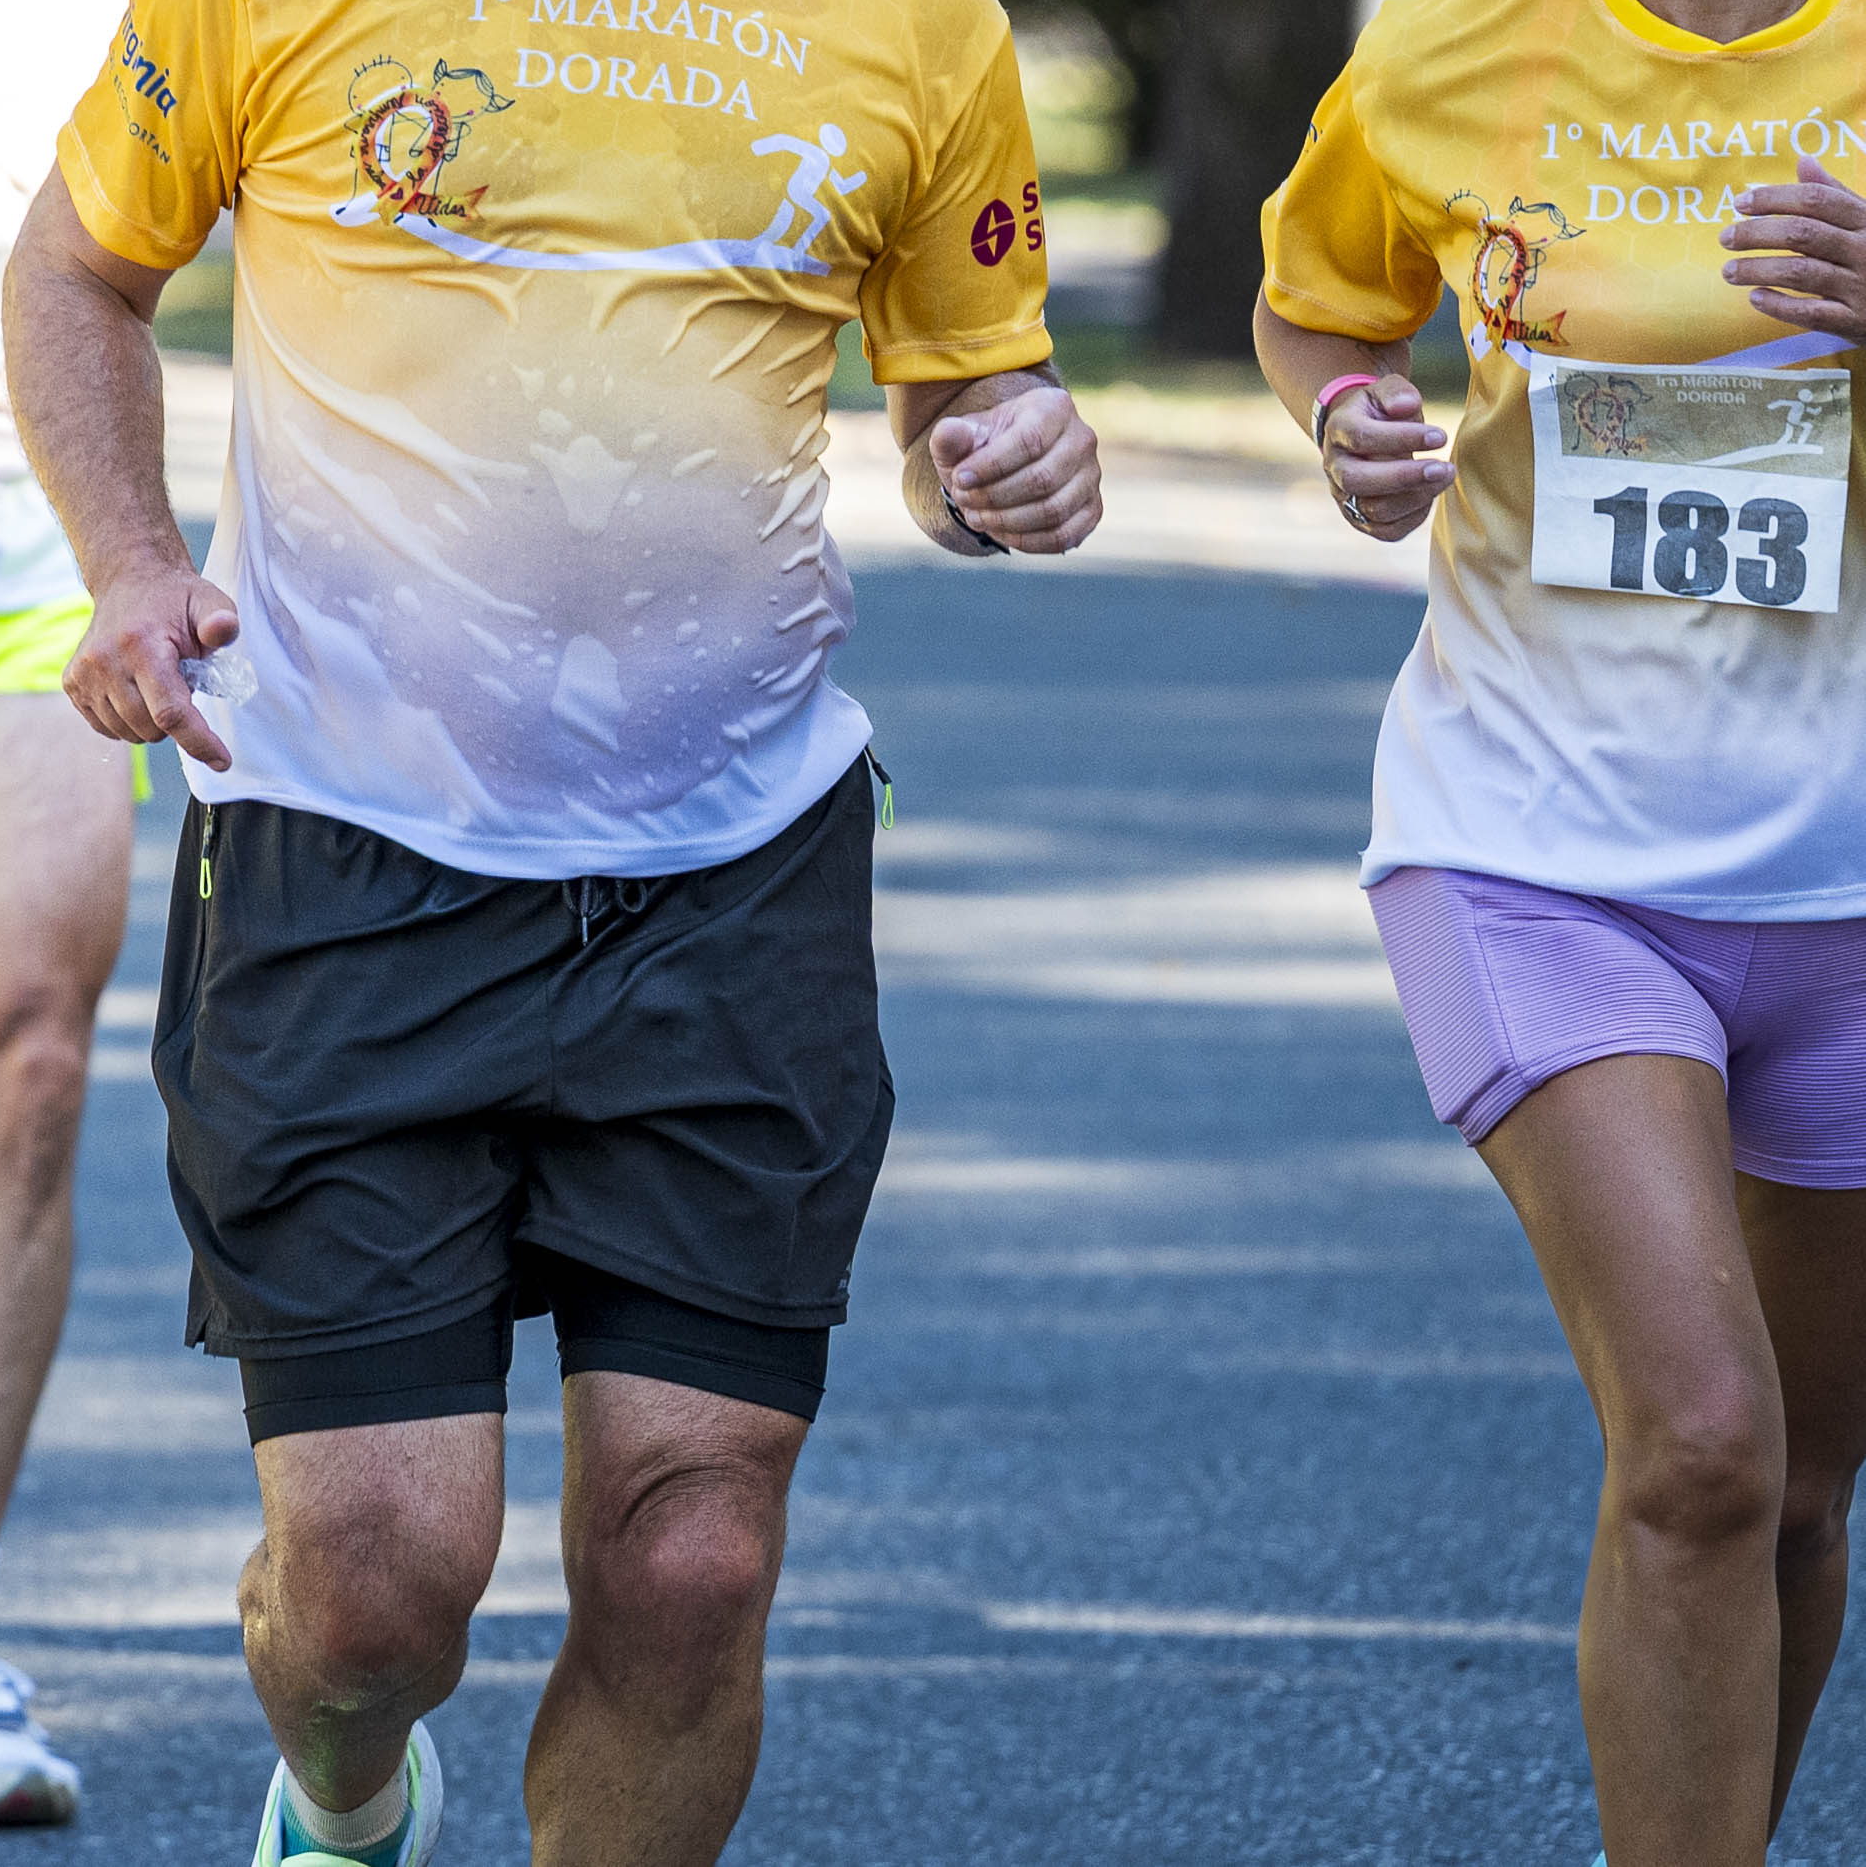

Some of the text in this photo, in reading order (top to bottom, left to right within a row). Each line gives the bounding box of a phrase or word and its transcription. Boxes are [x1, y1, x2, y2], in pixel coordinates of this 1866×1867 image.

[514, 47, 759, 122] DORADA
[1598, 106, 1866, 161] MARATÓN
[1584, 183, 1770, 226] DORA
[1676, 390, 1747, 405] DORADA
[1593, 486, 1809, 606] 183
